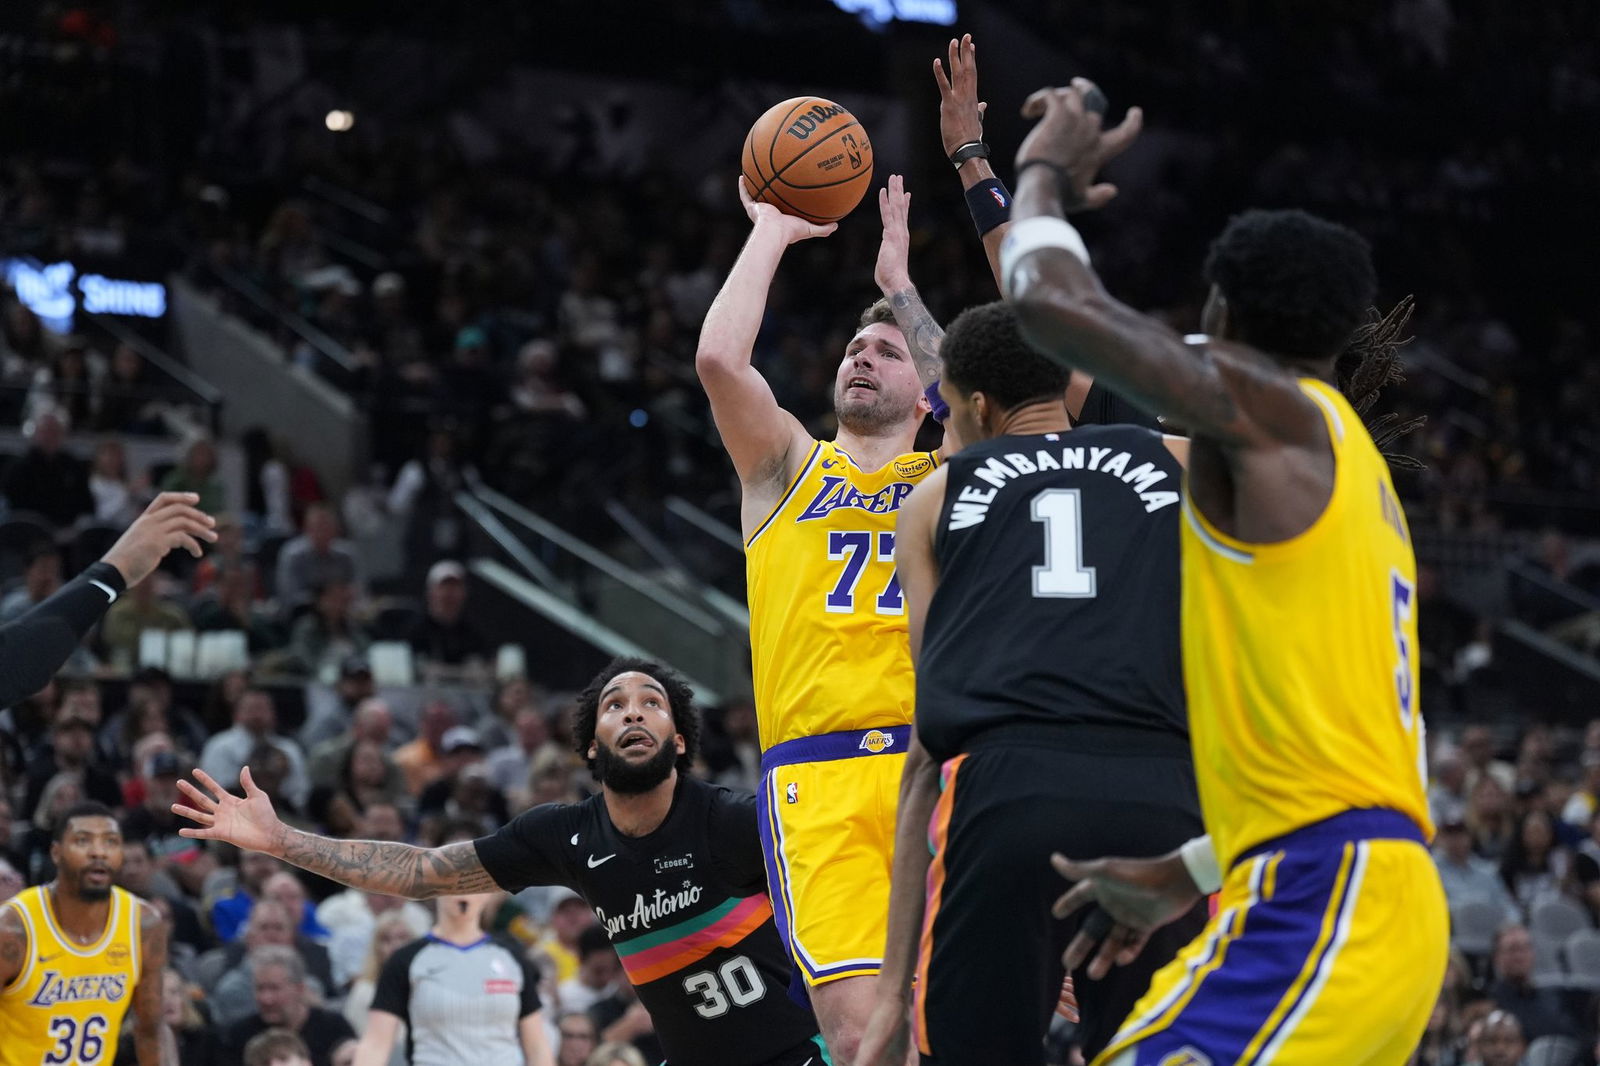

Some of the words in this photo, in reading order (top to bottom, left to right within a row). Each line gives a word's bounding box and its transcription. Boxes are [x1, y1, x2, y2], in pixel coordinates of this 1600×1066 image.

[795, 474, 914, 524] LAKER
[948, 446, 1180, 532] WEMBANYAMA
[1030, 488, 1097, 598] 1
[659, 858, 688, 869] LEDGER
[627, 880, 703, 929] Antonio
[25, 969, 127, 1009] LAKERS
[682, 954, 768, 1020] 30
[42, 1013, 109, 1066] 36
